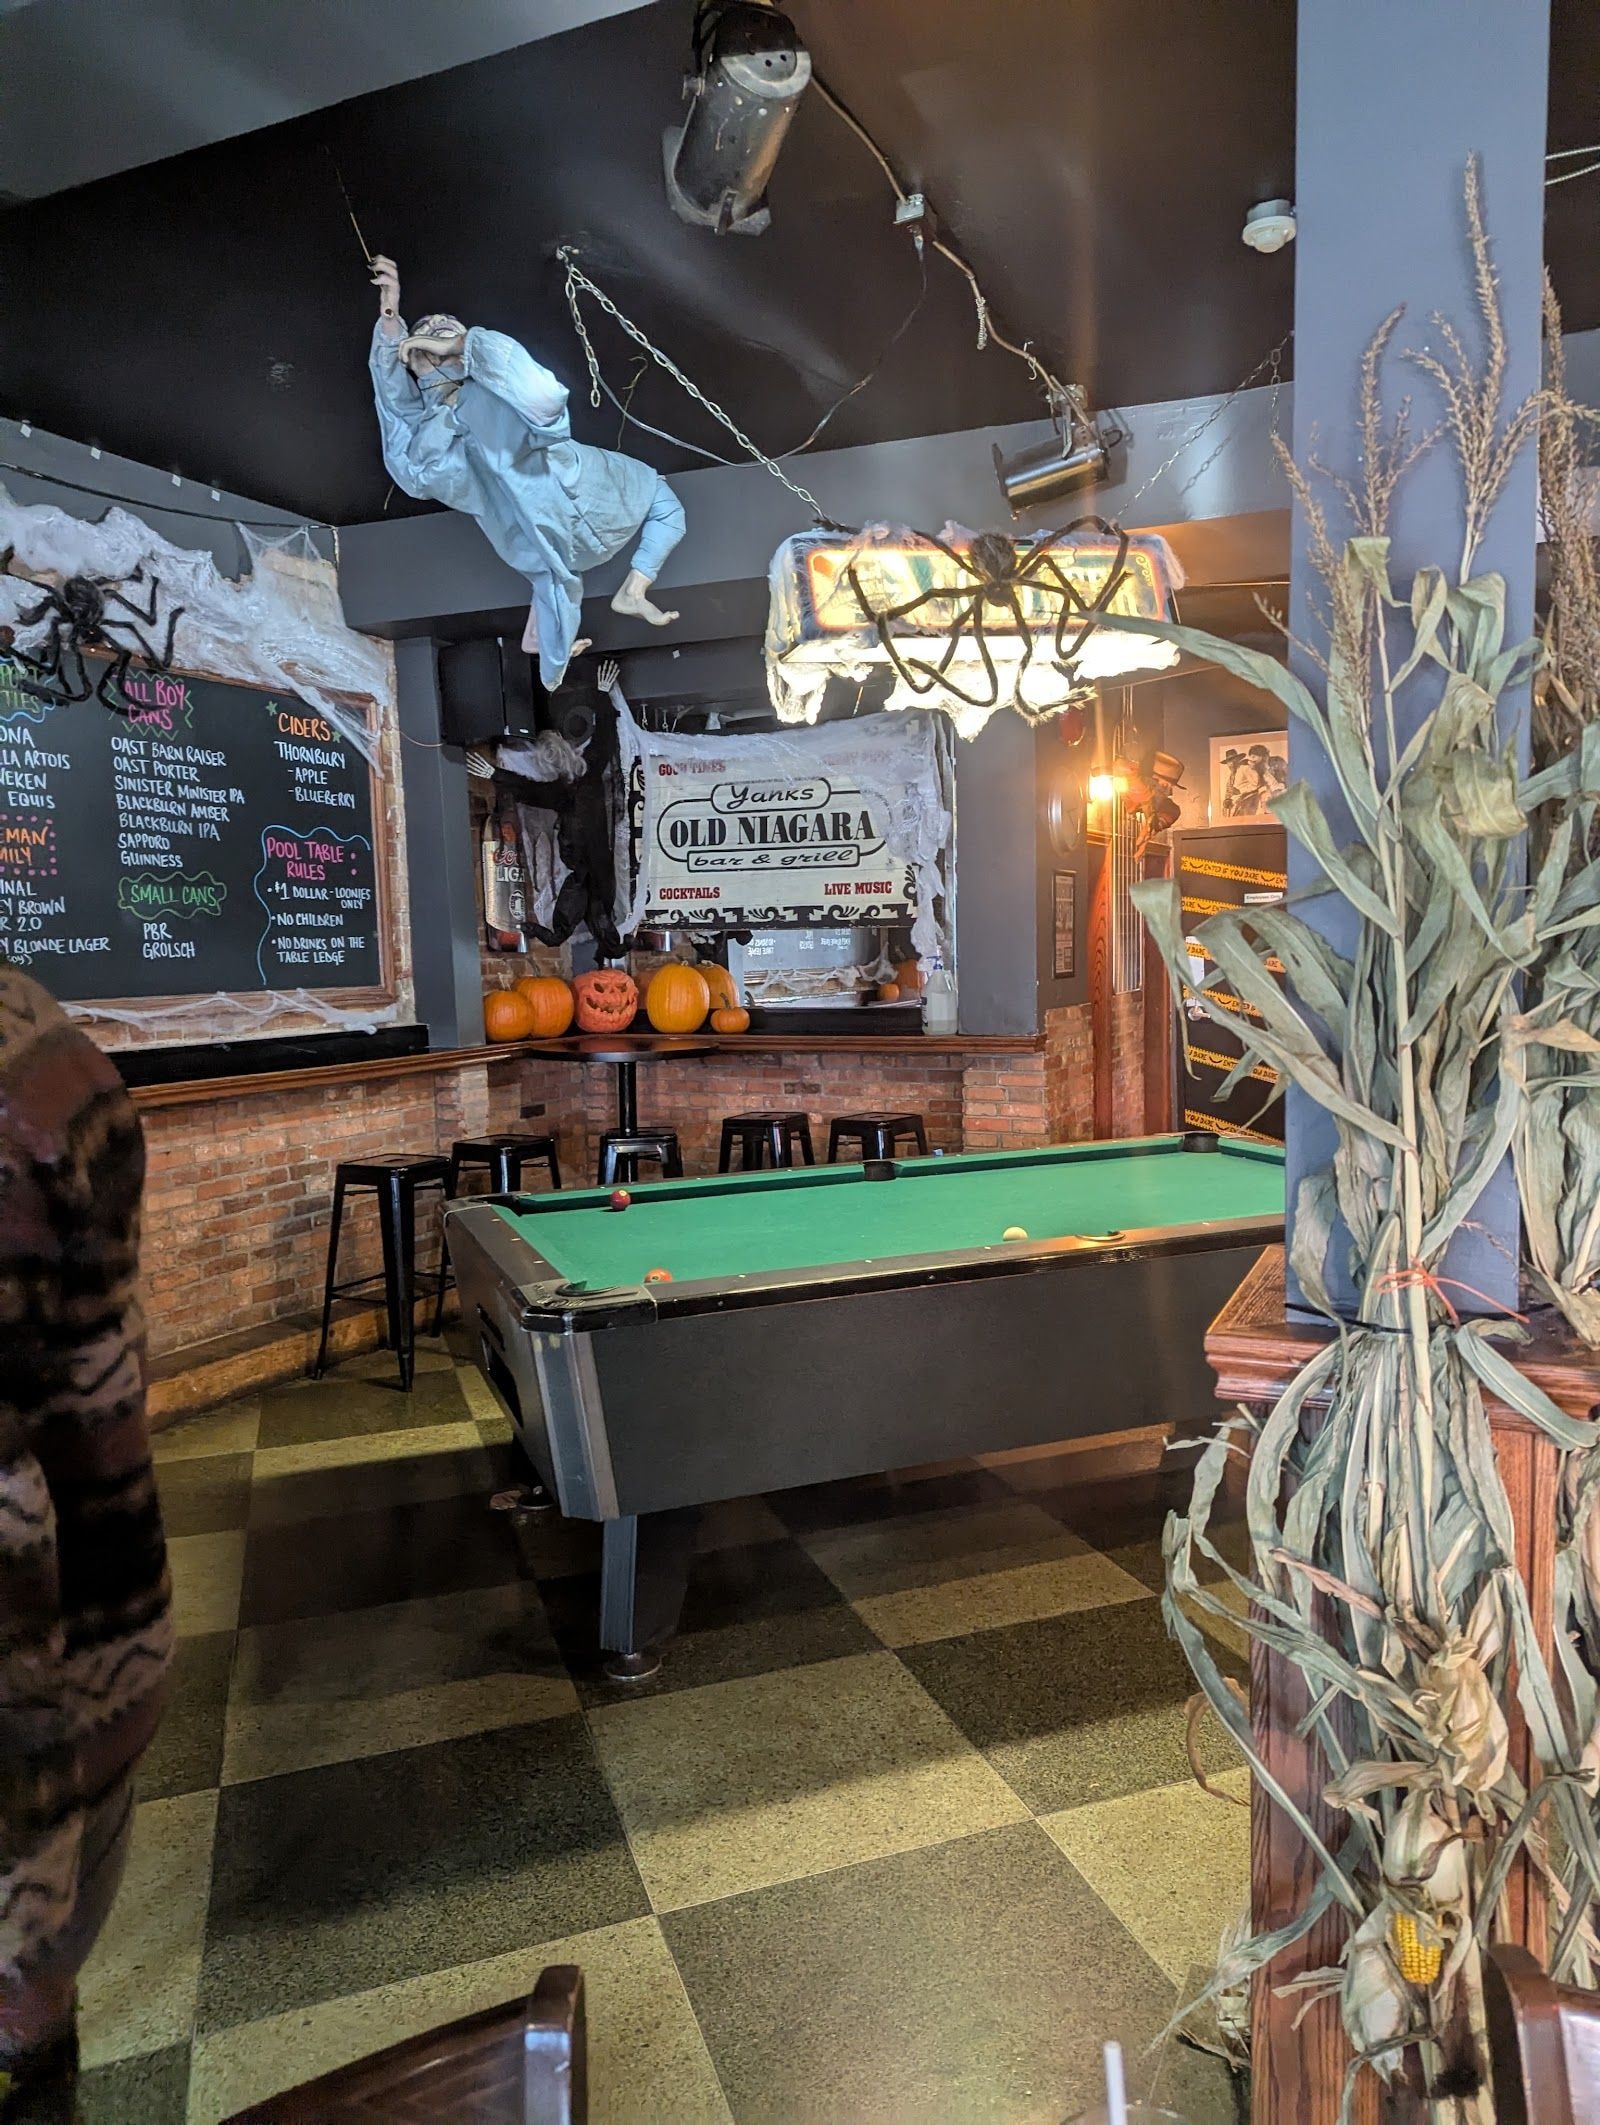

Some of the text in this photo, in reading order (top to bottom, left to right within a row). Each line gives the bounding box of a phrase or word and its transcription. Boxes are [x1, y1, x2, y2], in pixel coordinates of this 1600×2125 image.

[155, 680, 185, 710] BOY
[128, 704, 172, 730] CANS
[278, 712, 331, 741] CIDERS
[25, 750, 71, 769] ARTOIS
[112, 737, 227, 766] OAST BARN RAISER
[273, 740, 346, 769] THORNBURY
[113, 757, 200, 782] OAST PORTER
[115, 775, 245, 804] SINISTER MINISTER IPA
[8, 791, 55, 809] EQUIS
[116, 794, 230, 822] BLACKBURN AMBER
[119, 813, 220, 841] BLACKBURN IPA
[670, 811, 876, 848] OLD NIAGARA
[117, 833, 170, 850] SAPPORO
[267, 837, 345, 863] POOL TABLE
[120, 851, 183, 868] GUINNESS
[694, 850, 853, 866] bar & grill
[286, 861, 326, 880] RULES
[131, 884, 217, 906] SMALL CANS
[660, 887, 720, 900] COCKTAILS
[824, 881, 892, 895] LIVE MUSIC
[18, 896, 66, 915] BROWN
[341, 900, 363, 909] ONLY
[17, 917, 42, 932] 2.0
[277, 912, 344, 927] NO CHILDREN
[143, 922, 173, 940] PBR
[14, 938, 66, 954] BLONDE
[69, 937, 111, 954] LAGER
[142, 942, 196, 960] GROLSCH
[277, 936, 365, 950] NO DRINKS ON THE
[277, 950, 345, 966] TABLE LEDGE
